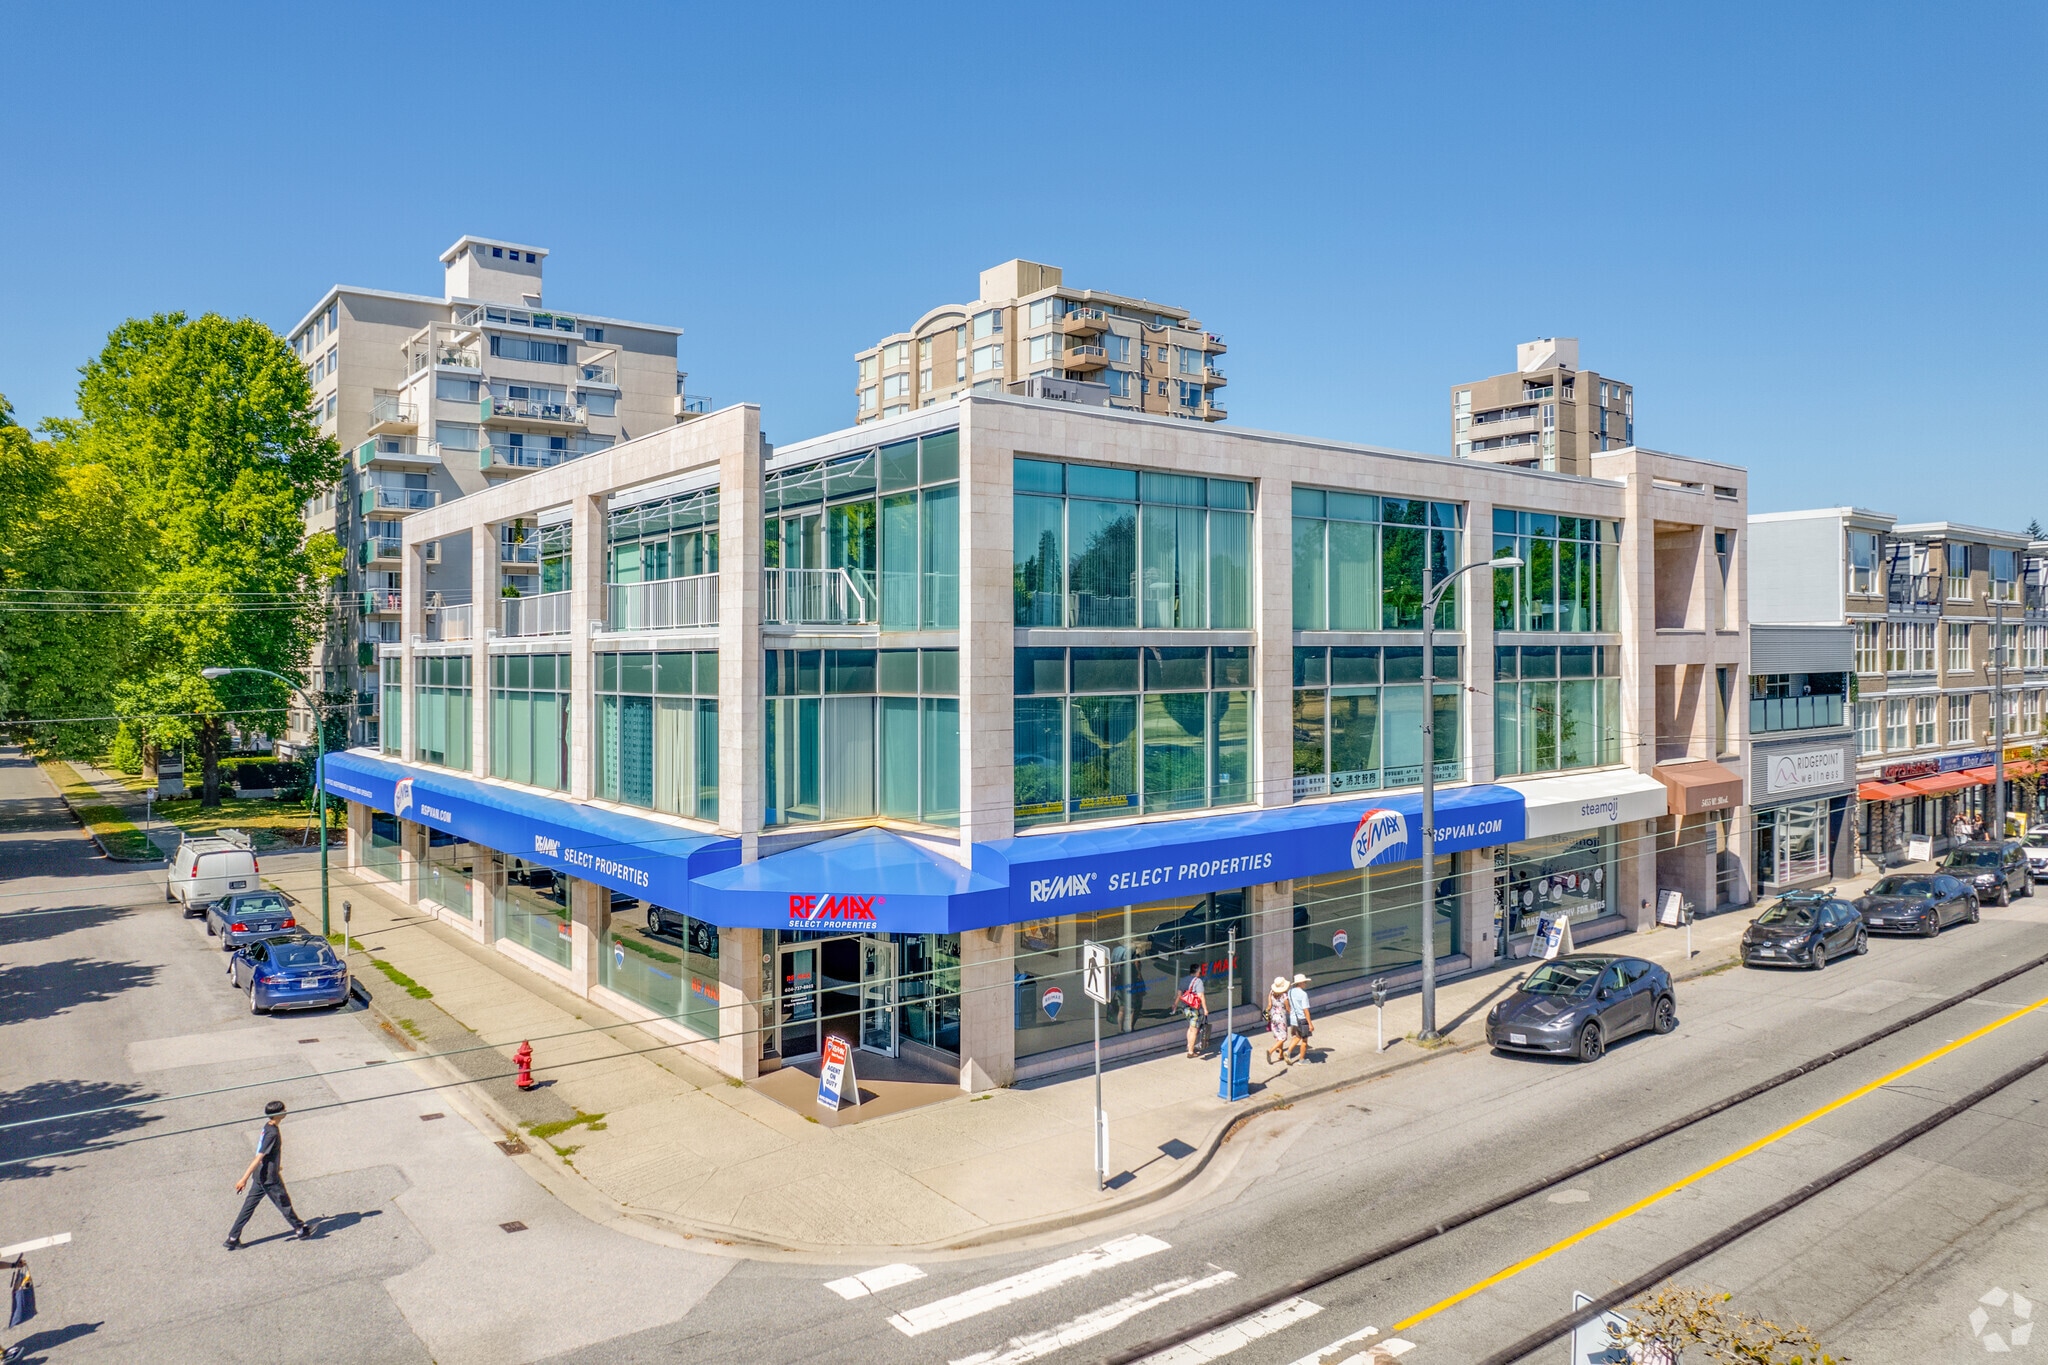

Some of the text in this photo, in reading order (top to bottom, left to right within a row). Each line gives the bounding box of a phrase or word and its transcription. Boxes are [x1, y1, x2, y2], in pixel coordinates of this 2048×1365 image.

[1797, 753, 1838, 770] RIDGEPOINT
[1801, 771, 1839, 783] wellness
[421, 804, 452, 823] RSPVAN.COM
[1581, 797, 1618, 821] steamoji
[1356, 814, 1400, 860] RE/MAX
[1433, 819, 1502, 842] RSPVAN.COM
[564, 848, 594, 869] SELECT
[595, 856, 649, 888] PROPERTIES
[1108, 866, 1173, 891] SELECT
[1178, 852, 1273, 881] PROPERTIES
[789, 920, 877, 929] SELECT PROPERTIES
[1521, 915, 1540, 928] MAKE
[1590, 900, 1606, 912] KIDS
[1201, 956, 1238, 976] E/MAX
[691, 977, 719, 1001] RE/MA
[827, 1065, 841, 1075] AGENT
[826, 1079, 838, 1088] DUTY
